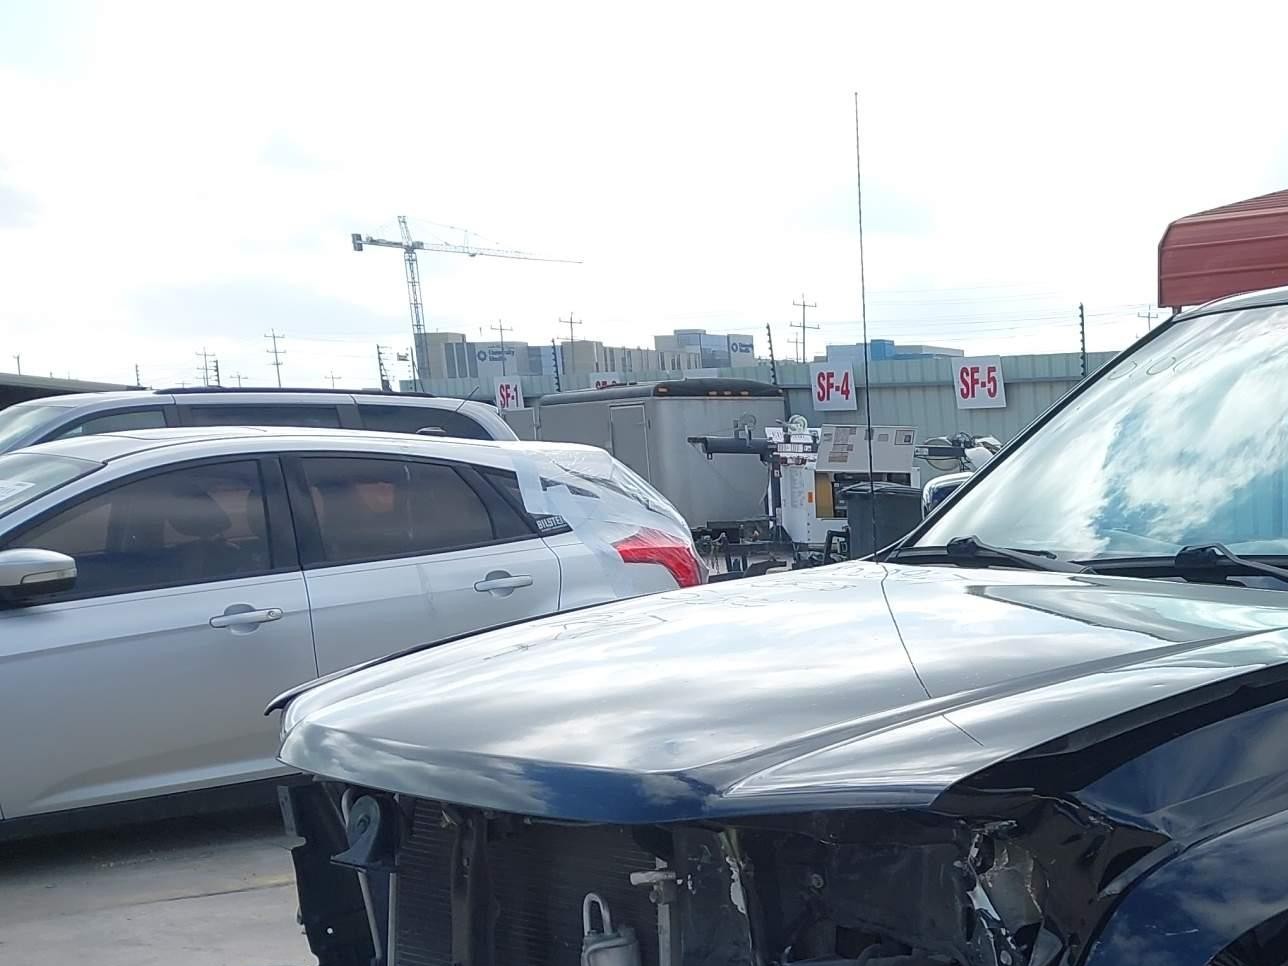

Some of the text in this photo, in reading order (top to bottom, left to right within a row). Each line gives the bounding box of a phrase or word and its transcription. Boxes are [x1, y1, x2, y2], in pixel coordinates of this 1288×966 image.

[499, 383, 519, 409] SF-1
[816, 371, 851, 402] SF-4
[959, 366, 998, 400] SF-5
